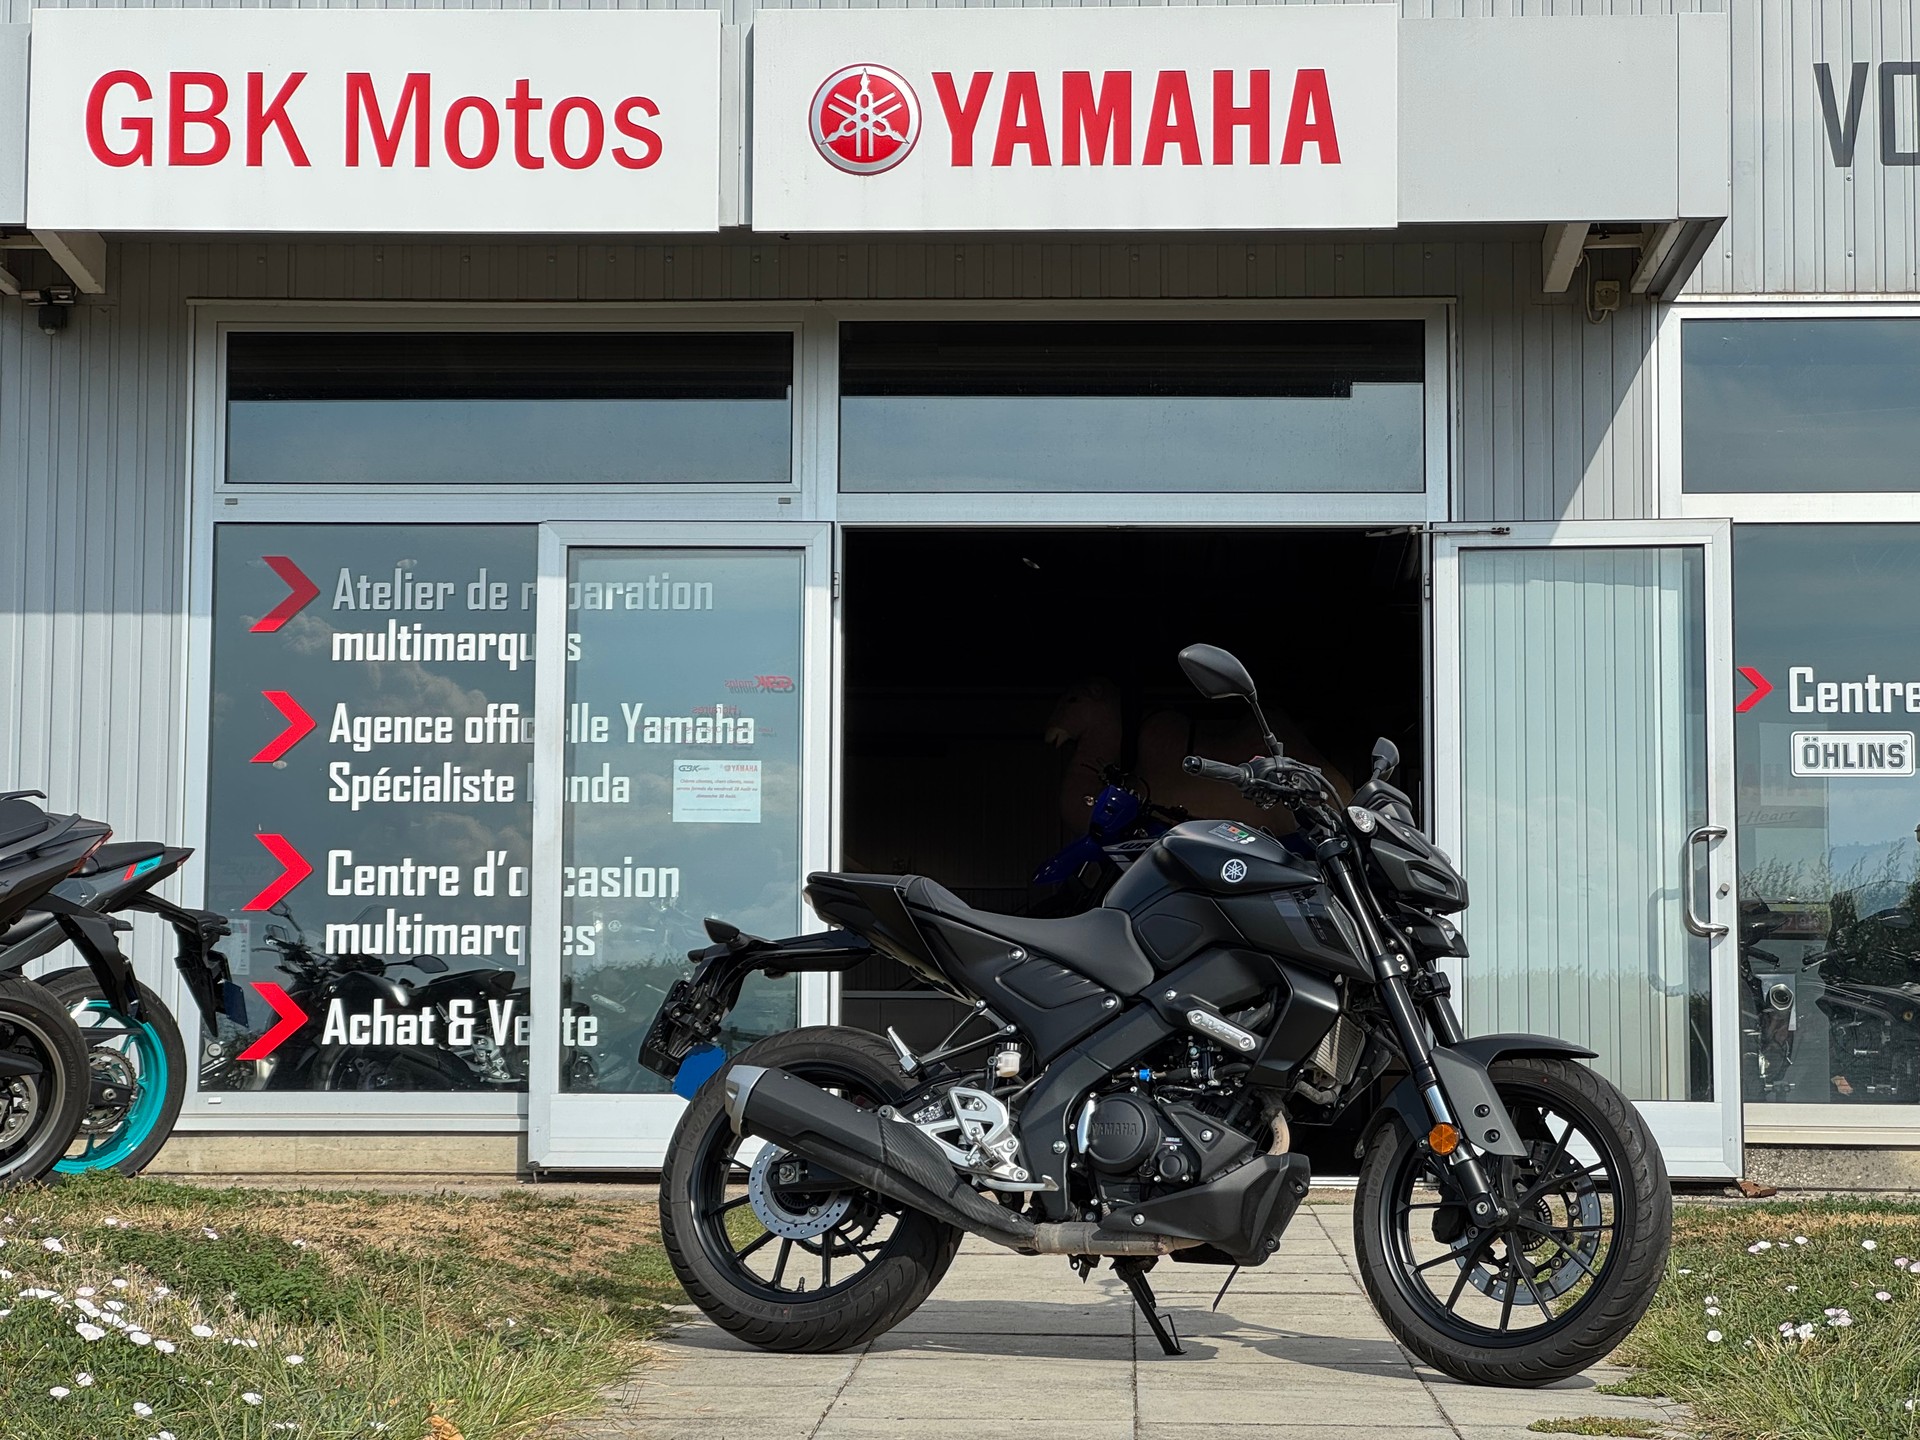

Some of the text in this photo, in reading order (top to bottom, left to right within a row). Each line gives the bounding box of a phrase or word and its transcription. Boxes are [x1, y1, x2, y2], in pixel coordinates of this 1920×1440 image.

[85, 70, 664, 170] GBK Motos
[931, 69, 1342, 167] YAMAHA
[332, 567, 713, 611] Atelier de rparation
[331, 618, 582, 671] multimarqus
[1789, 666, 1920, 713] Centre
[328, 702, 755, 752] Agence officlle Yamaha
[328, 761, 515, 811] Spécialiste
[327, 850, 680, 898] Centre d'ocasion
[325, 908, 596, 966] multimarqes
[321, 998, 598, 1047] Achat & Vete
